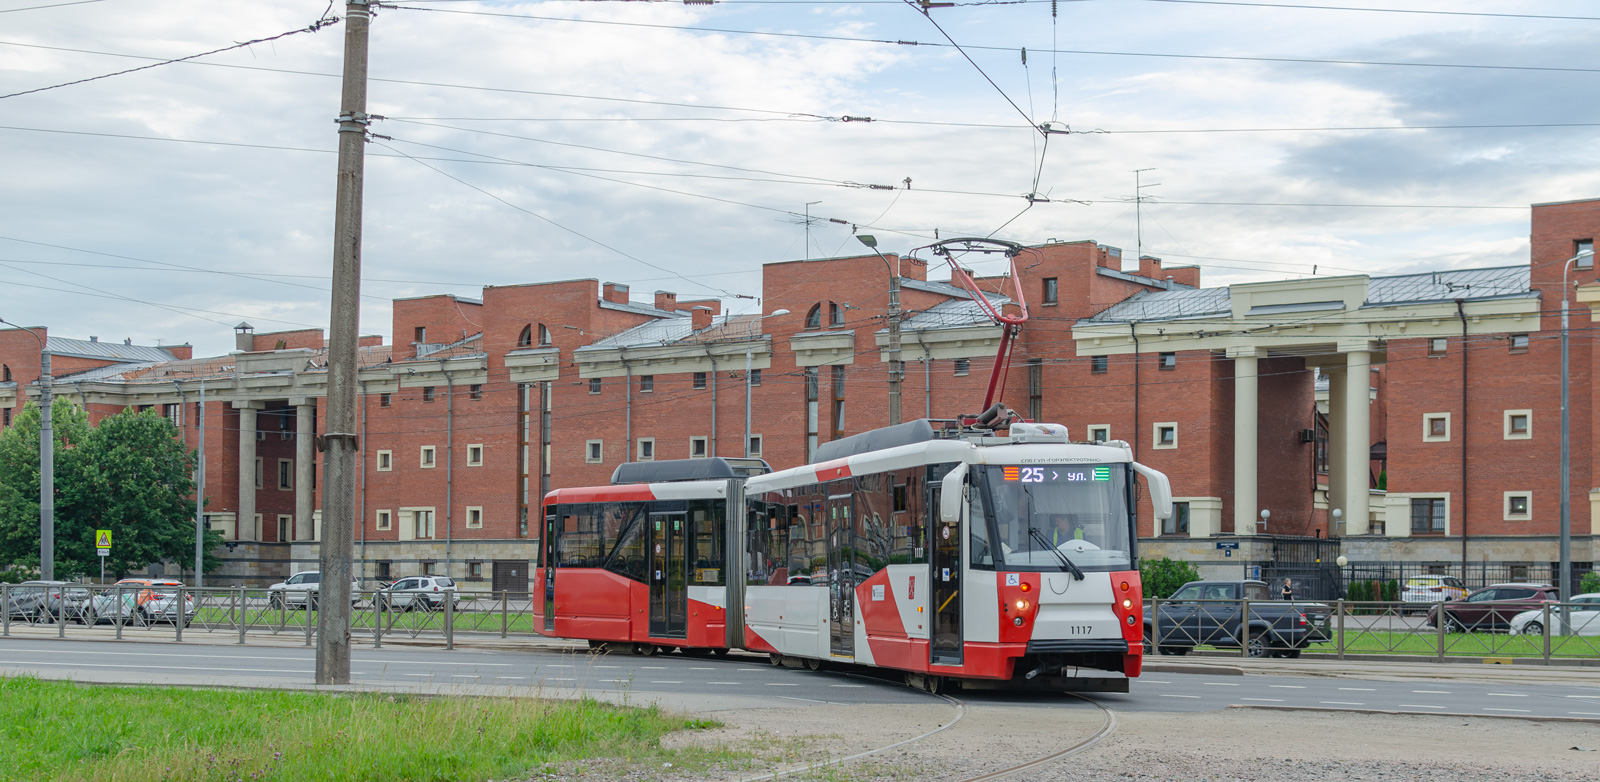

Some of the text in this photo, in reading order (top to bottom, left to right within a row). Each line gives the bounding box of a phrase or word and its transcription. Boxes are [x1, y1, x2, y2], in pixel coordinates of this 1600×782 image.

[1021, 467, 1044, 482] 25
[1067, 472, 1087, 481] ул.
[914, 547, 924, 558] 1117
[1071, 626, 1092, 634] 1117
